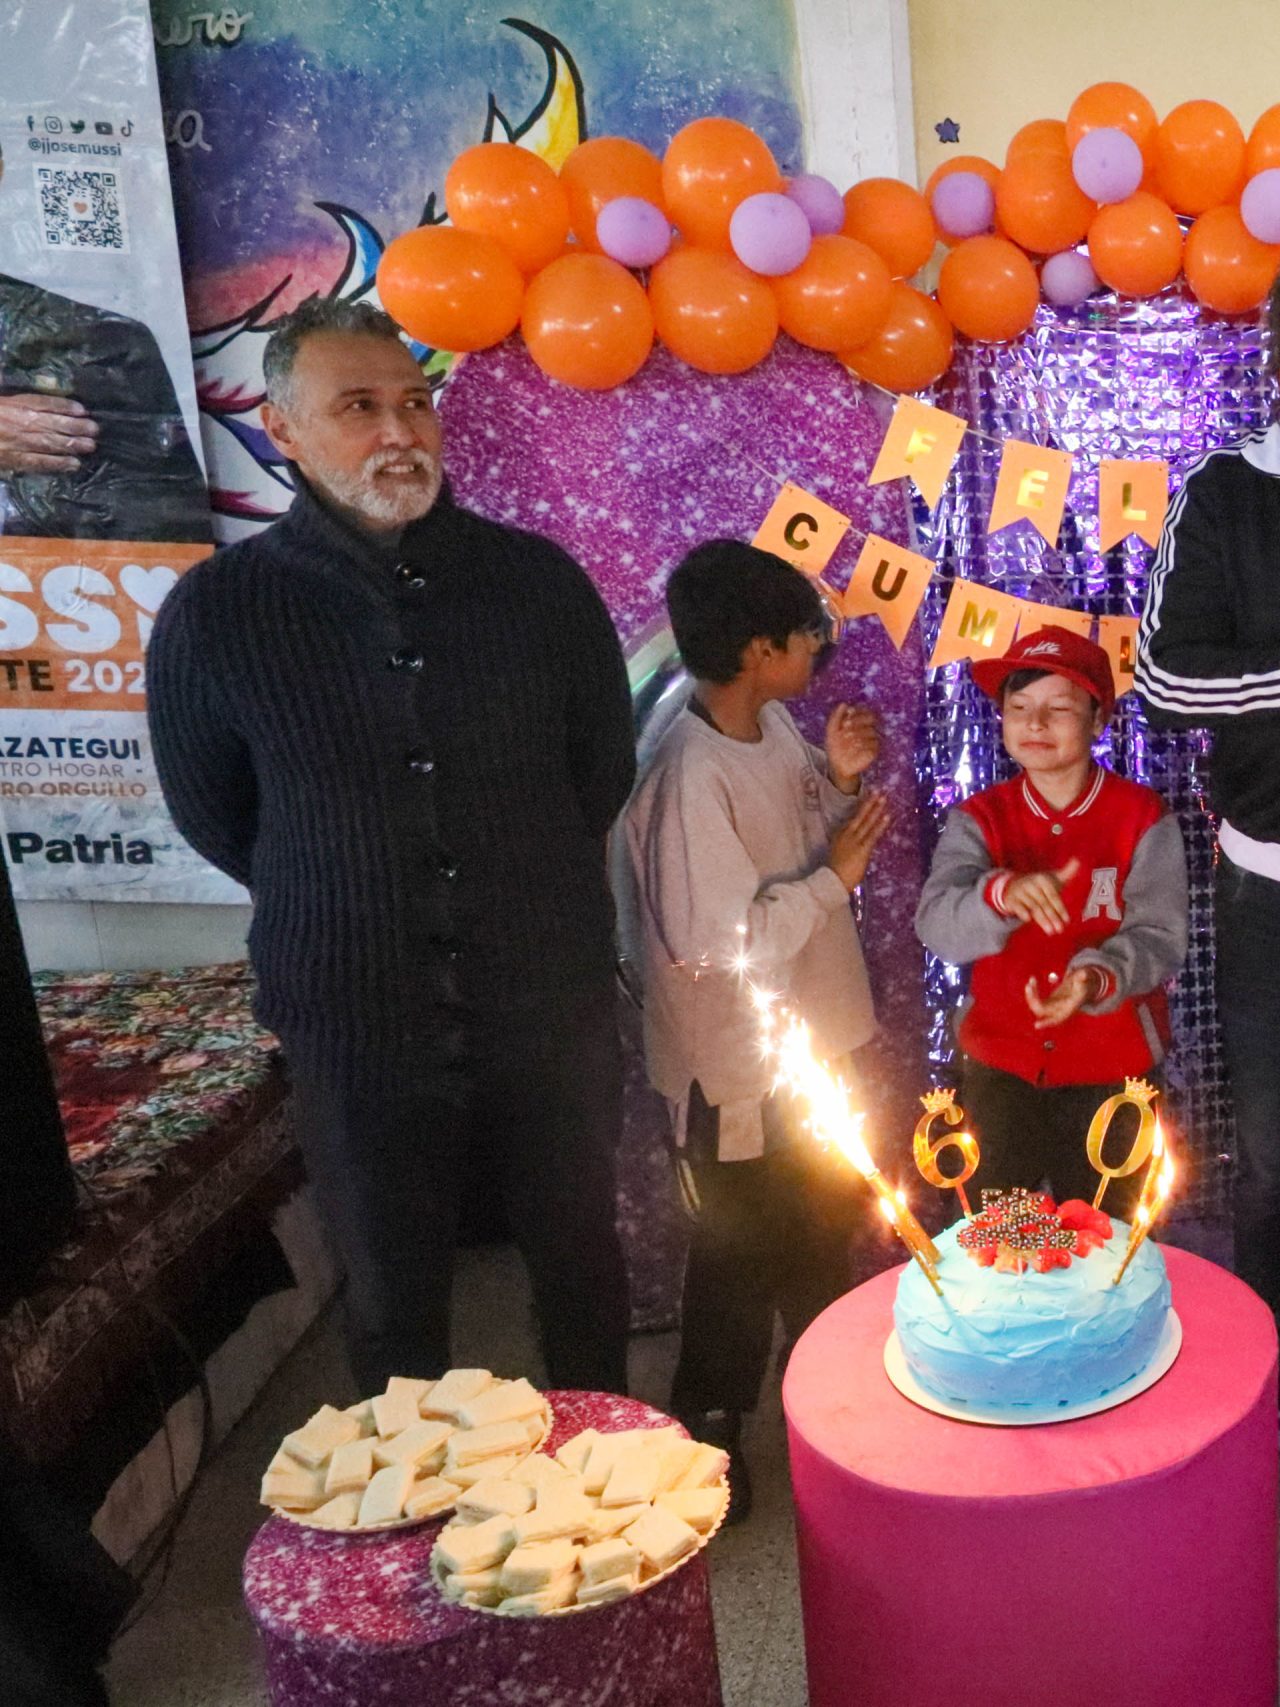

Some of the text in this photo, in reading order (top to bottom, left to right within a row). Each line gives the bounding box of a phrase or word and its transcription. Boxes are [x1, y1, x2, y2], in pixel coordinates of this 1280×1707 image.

[28, 137, 122, 157] @jjosemussi
[48, 763, 124, 778] HOGAR
[40, 782, 147, 798] ORGULLO
[6, 832, 154, 865] Patria
[1082, 867, 1122, 922] A
